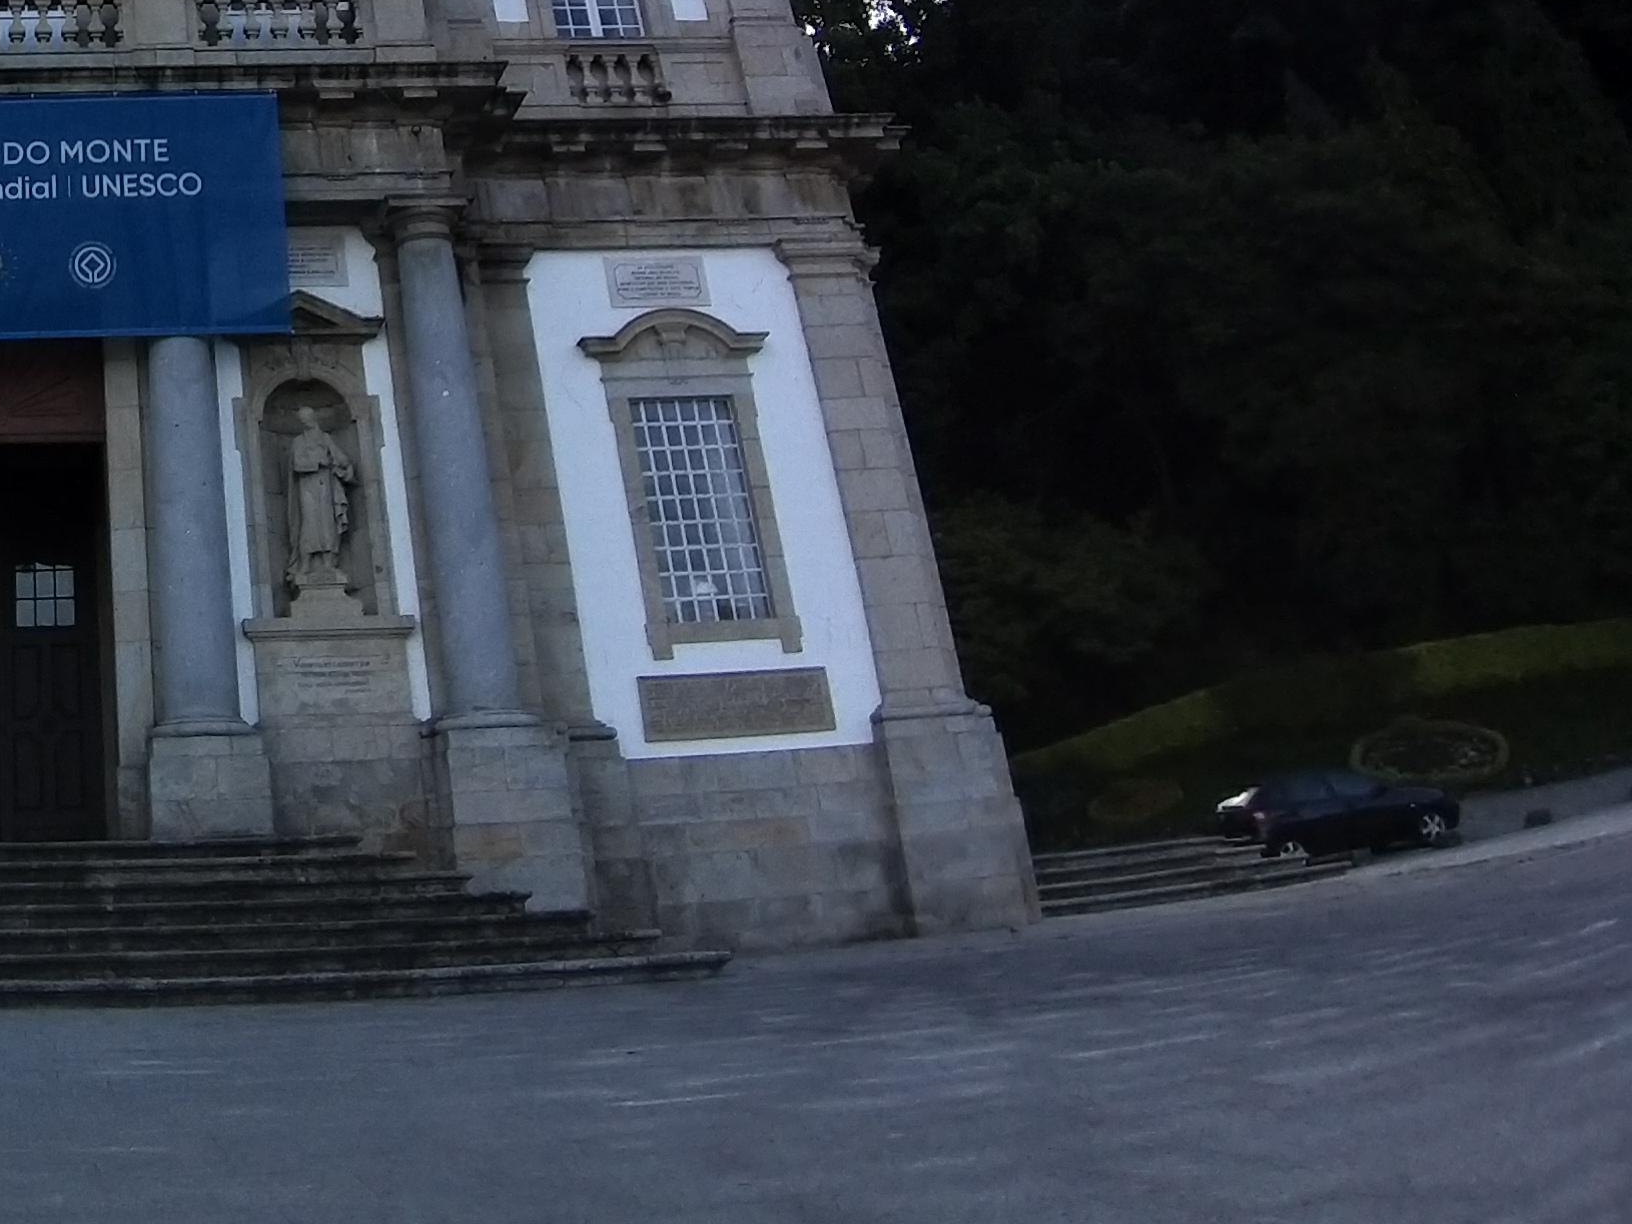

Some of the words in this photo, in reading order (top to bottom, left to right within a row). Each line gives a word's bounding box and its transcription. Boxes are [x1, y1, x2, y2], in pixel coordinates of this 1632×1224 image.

[3, 141, 50, 165] DO
[60, 139, 169, 164] MONTE
[82, 172, 202, 198] UNESCO
